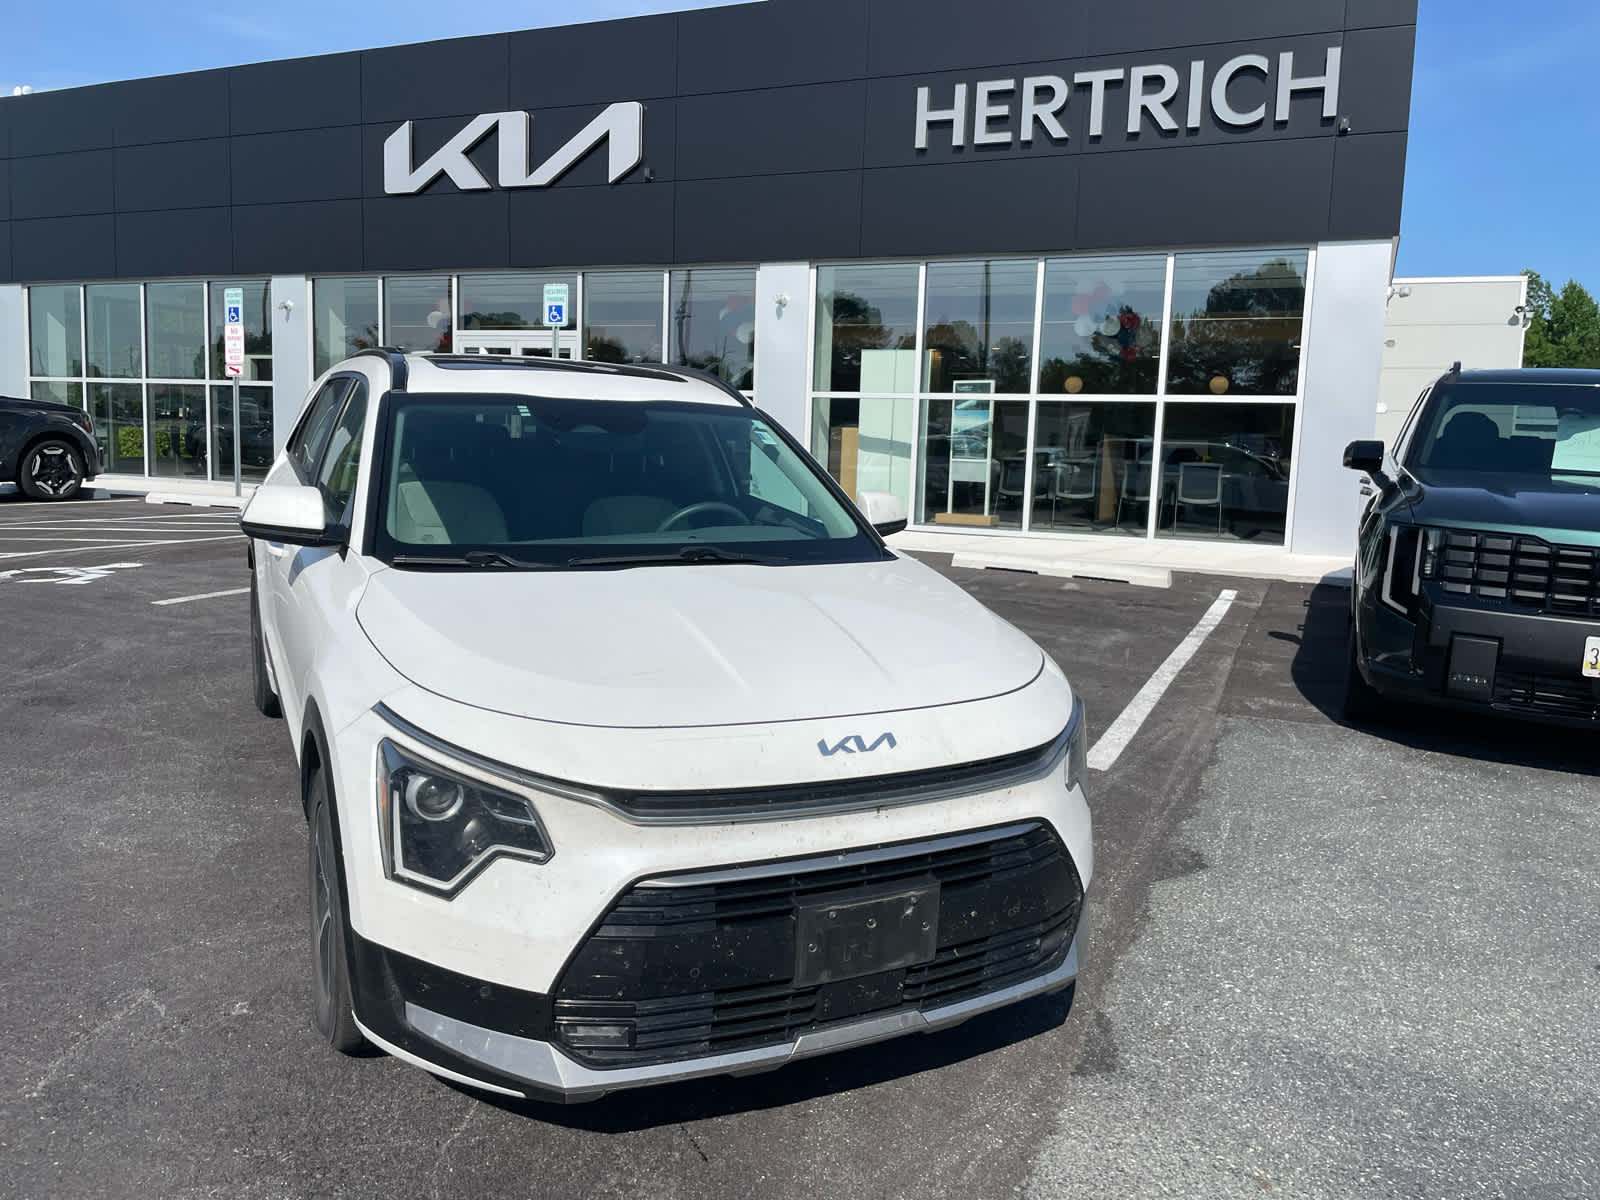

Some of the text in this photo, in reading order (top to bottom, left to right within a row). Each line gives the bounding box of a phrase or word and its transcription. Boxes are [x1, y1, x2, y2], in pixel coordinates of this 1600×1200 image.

[914, 46, 1342, 150] HERTRICH
[383, 101, 643, 194] KIA
[817, 732, 897, 756] KIA
